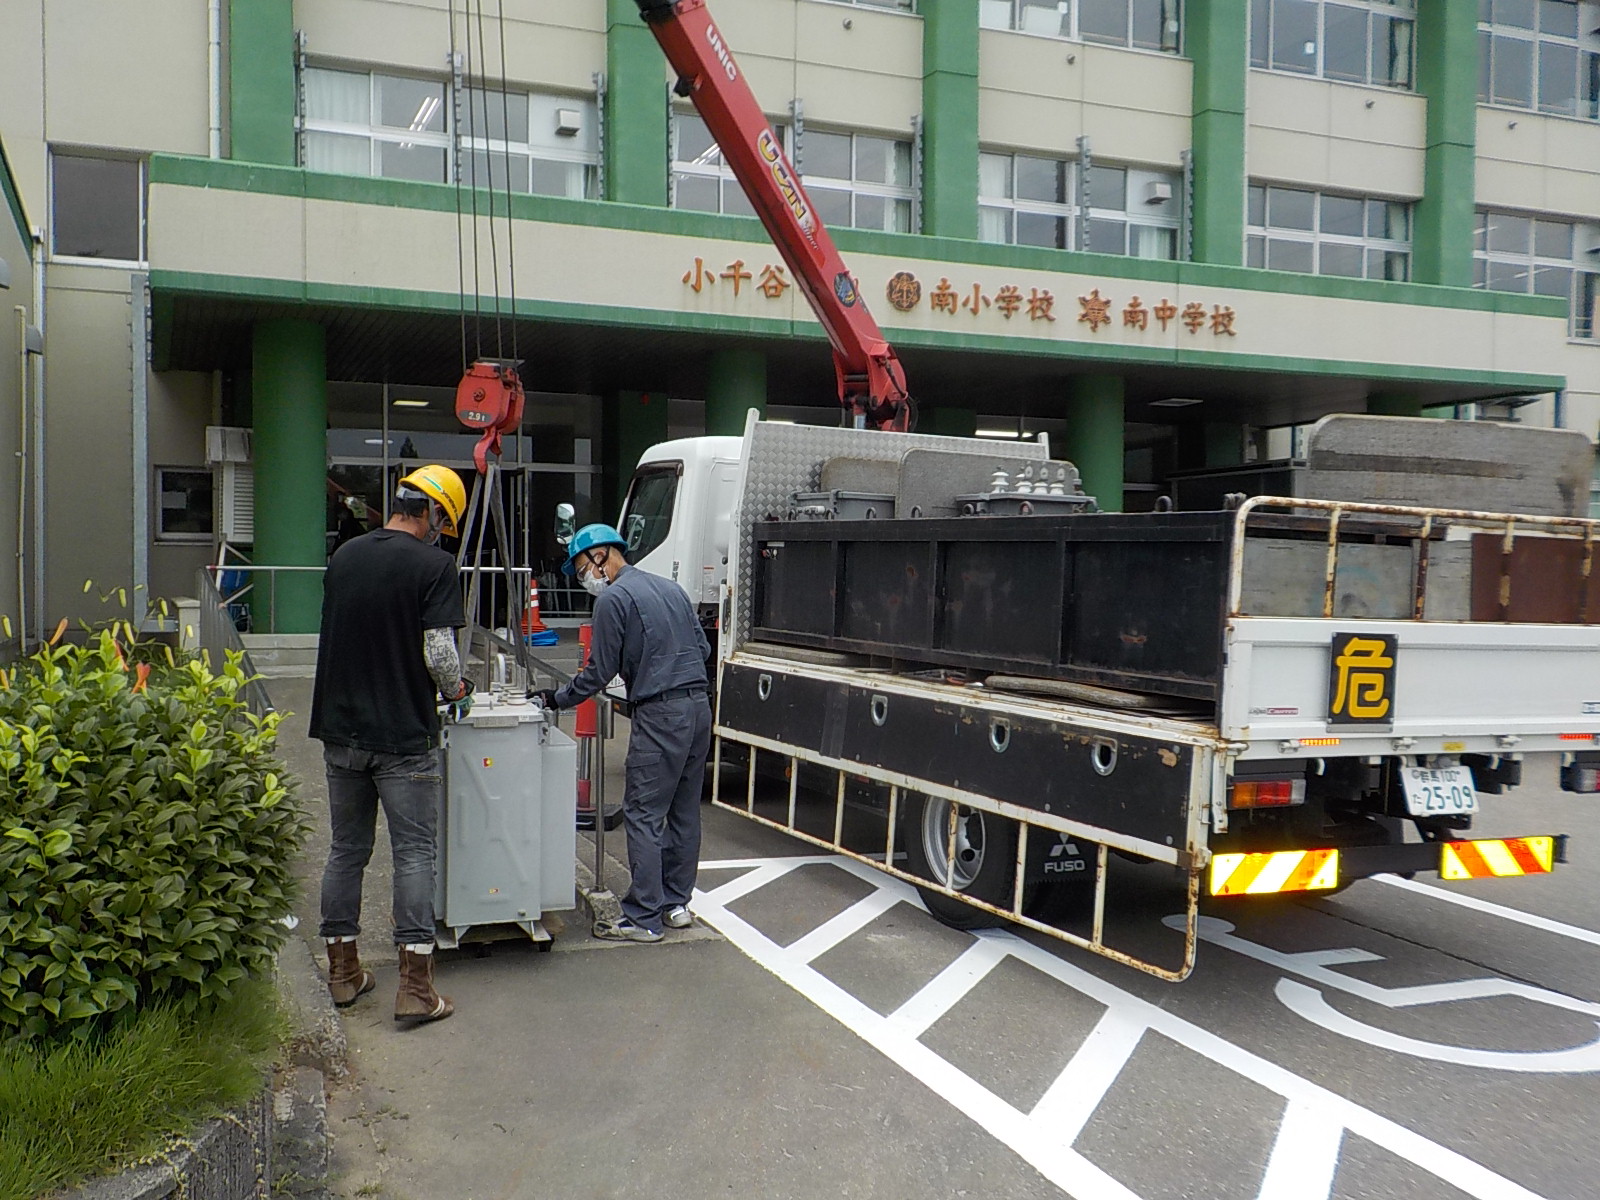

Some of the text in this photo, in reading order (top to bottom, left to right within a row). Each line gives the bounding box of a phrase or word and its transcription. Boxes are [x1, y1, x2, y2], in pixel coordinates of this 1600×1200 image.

[706, 23, 737, 81] UNIC
[682, 256, 1238, 337] 小千谷 南小学校 南中学校
[1331, 636, 1394, 718] 危
[1422, 785, 1474, 811] 25-09
[1043, 859, 1086, 874] FUSO
